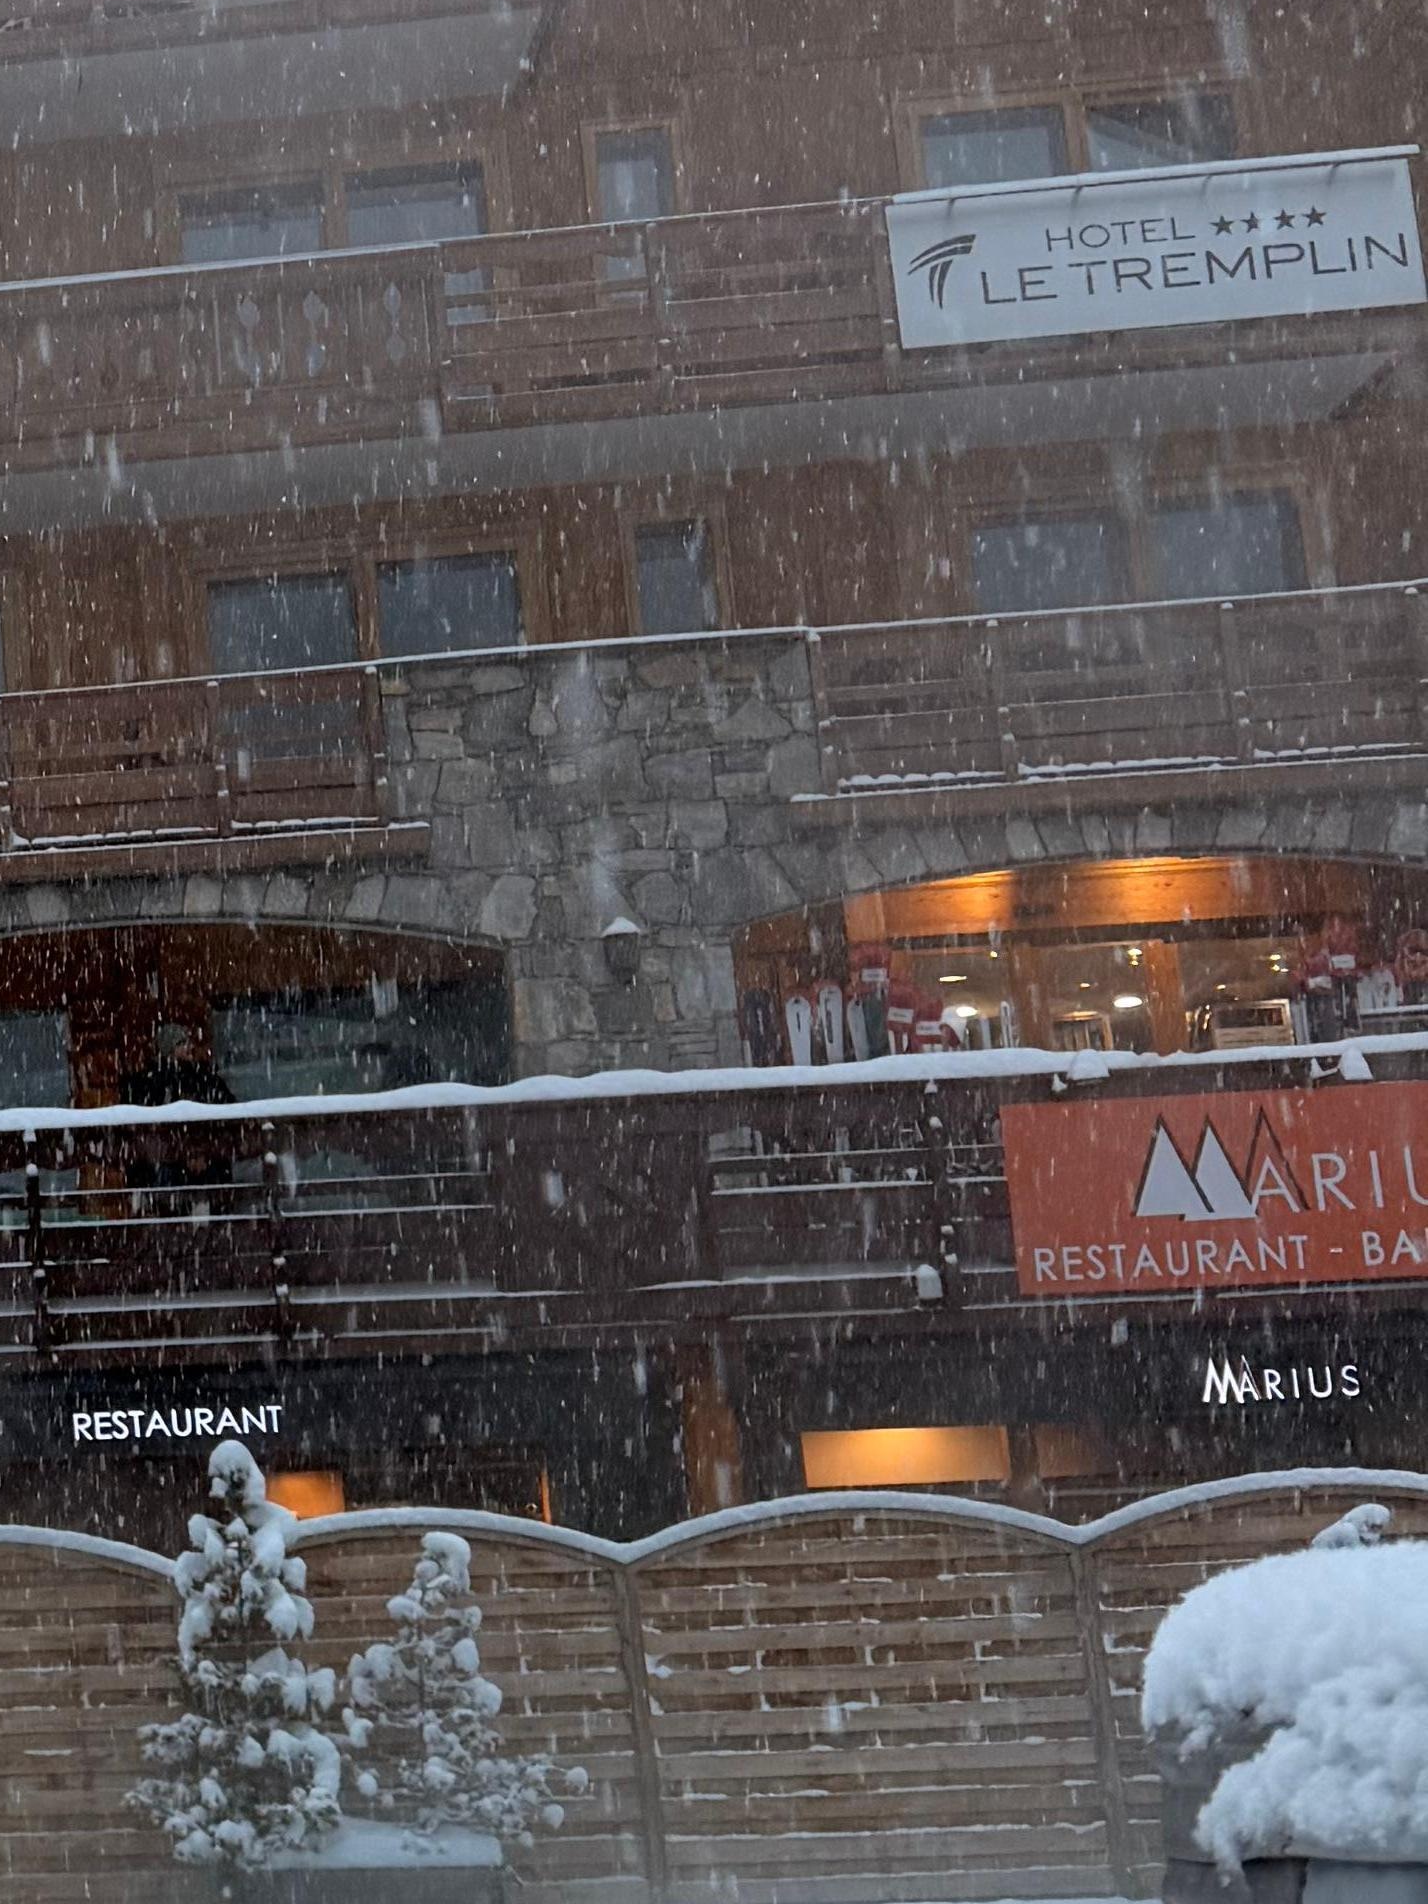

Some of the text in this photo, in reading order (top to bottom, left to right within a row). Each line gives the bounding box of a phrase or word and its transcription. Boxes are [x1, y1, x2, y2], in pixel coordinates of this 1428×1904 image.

[1045, 216, 1197, 253] HOTEL
[981, 233, 1410, 305] LE TREMPLIN
[1033, 1234, 1309, 1282] RESTAURANT
[1361, 1229, 1428, 1267] BA
[1201, 1354, 1361, 1404] MARIUS
[72, 1405, 283, 1442] RESTAURANT
